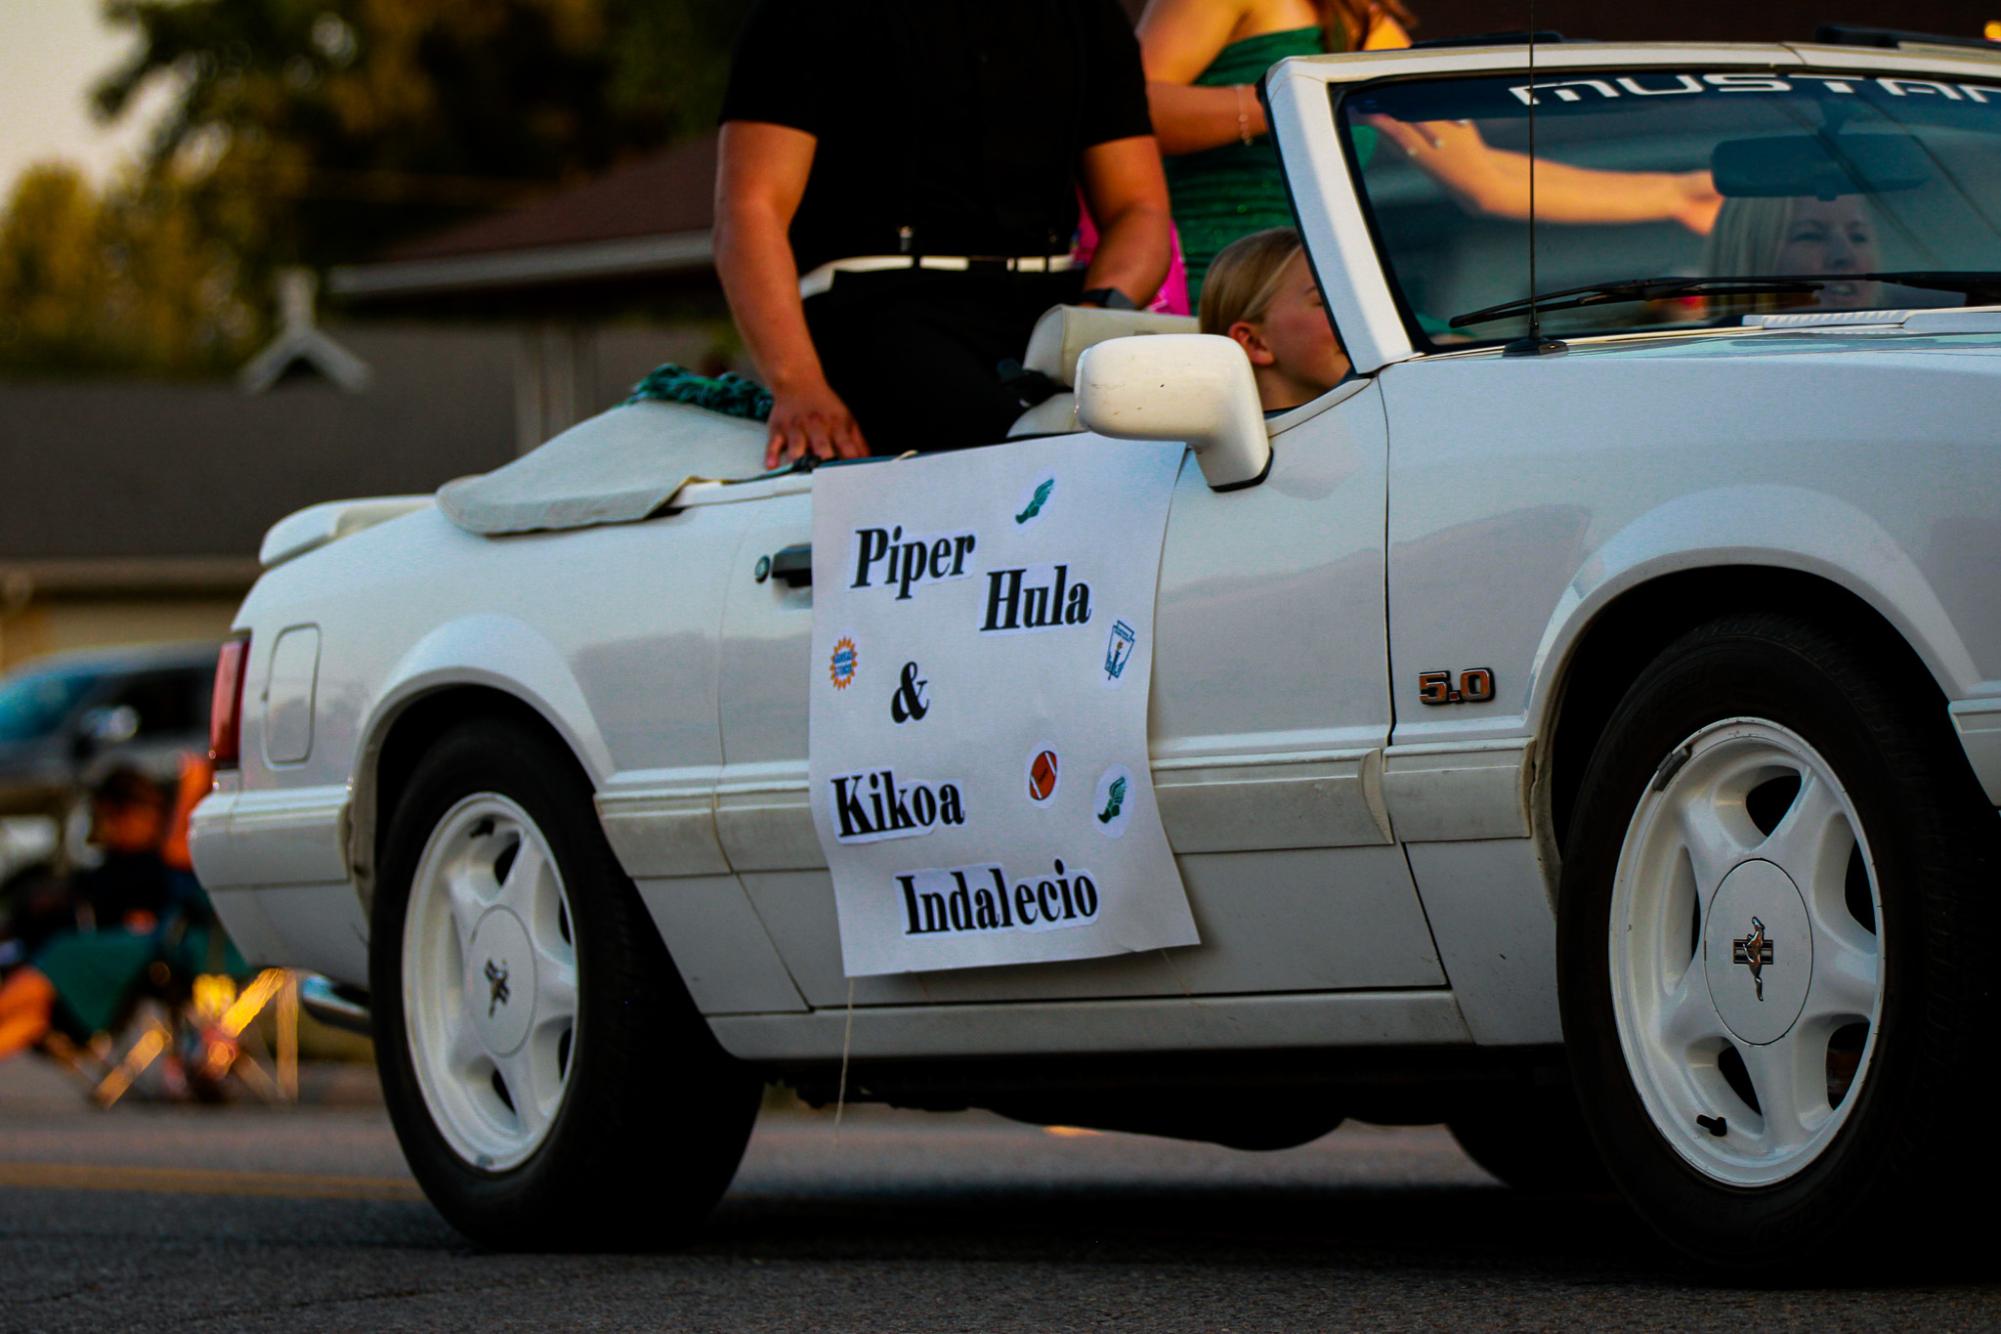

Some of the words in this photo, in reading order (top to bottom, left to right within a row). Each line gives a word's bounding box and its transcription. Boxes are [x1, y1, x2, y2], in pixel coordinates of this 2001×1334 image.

[850, 525, 976, 600] Piper
[980, 564, 1092, 632] Hula
[891, 661, 930, 724] &
[1418, 667, 1496, 705] 5.0
[831, 771, 966, 838] Kikoa
[896, 859, 1099, 936] Indalecio
